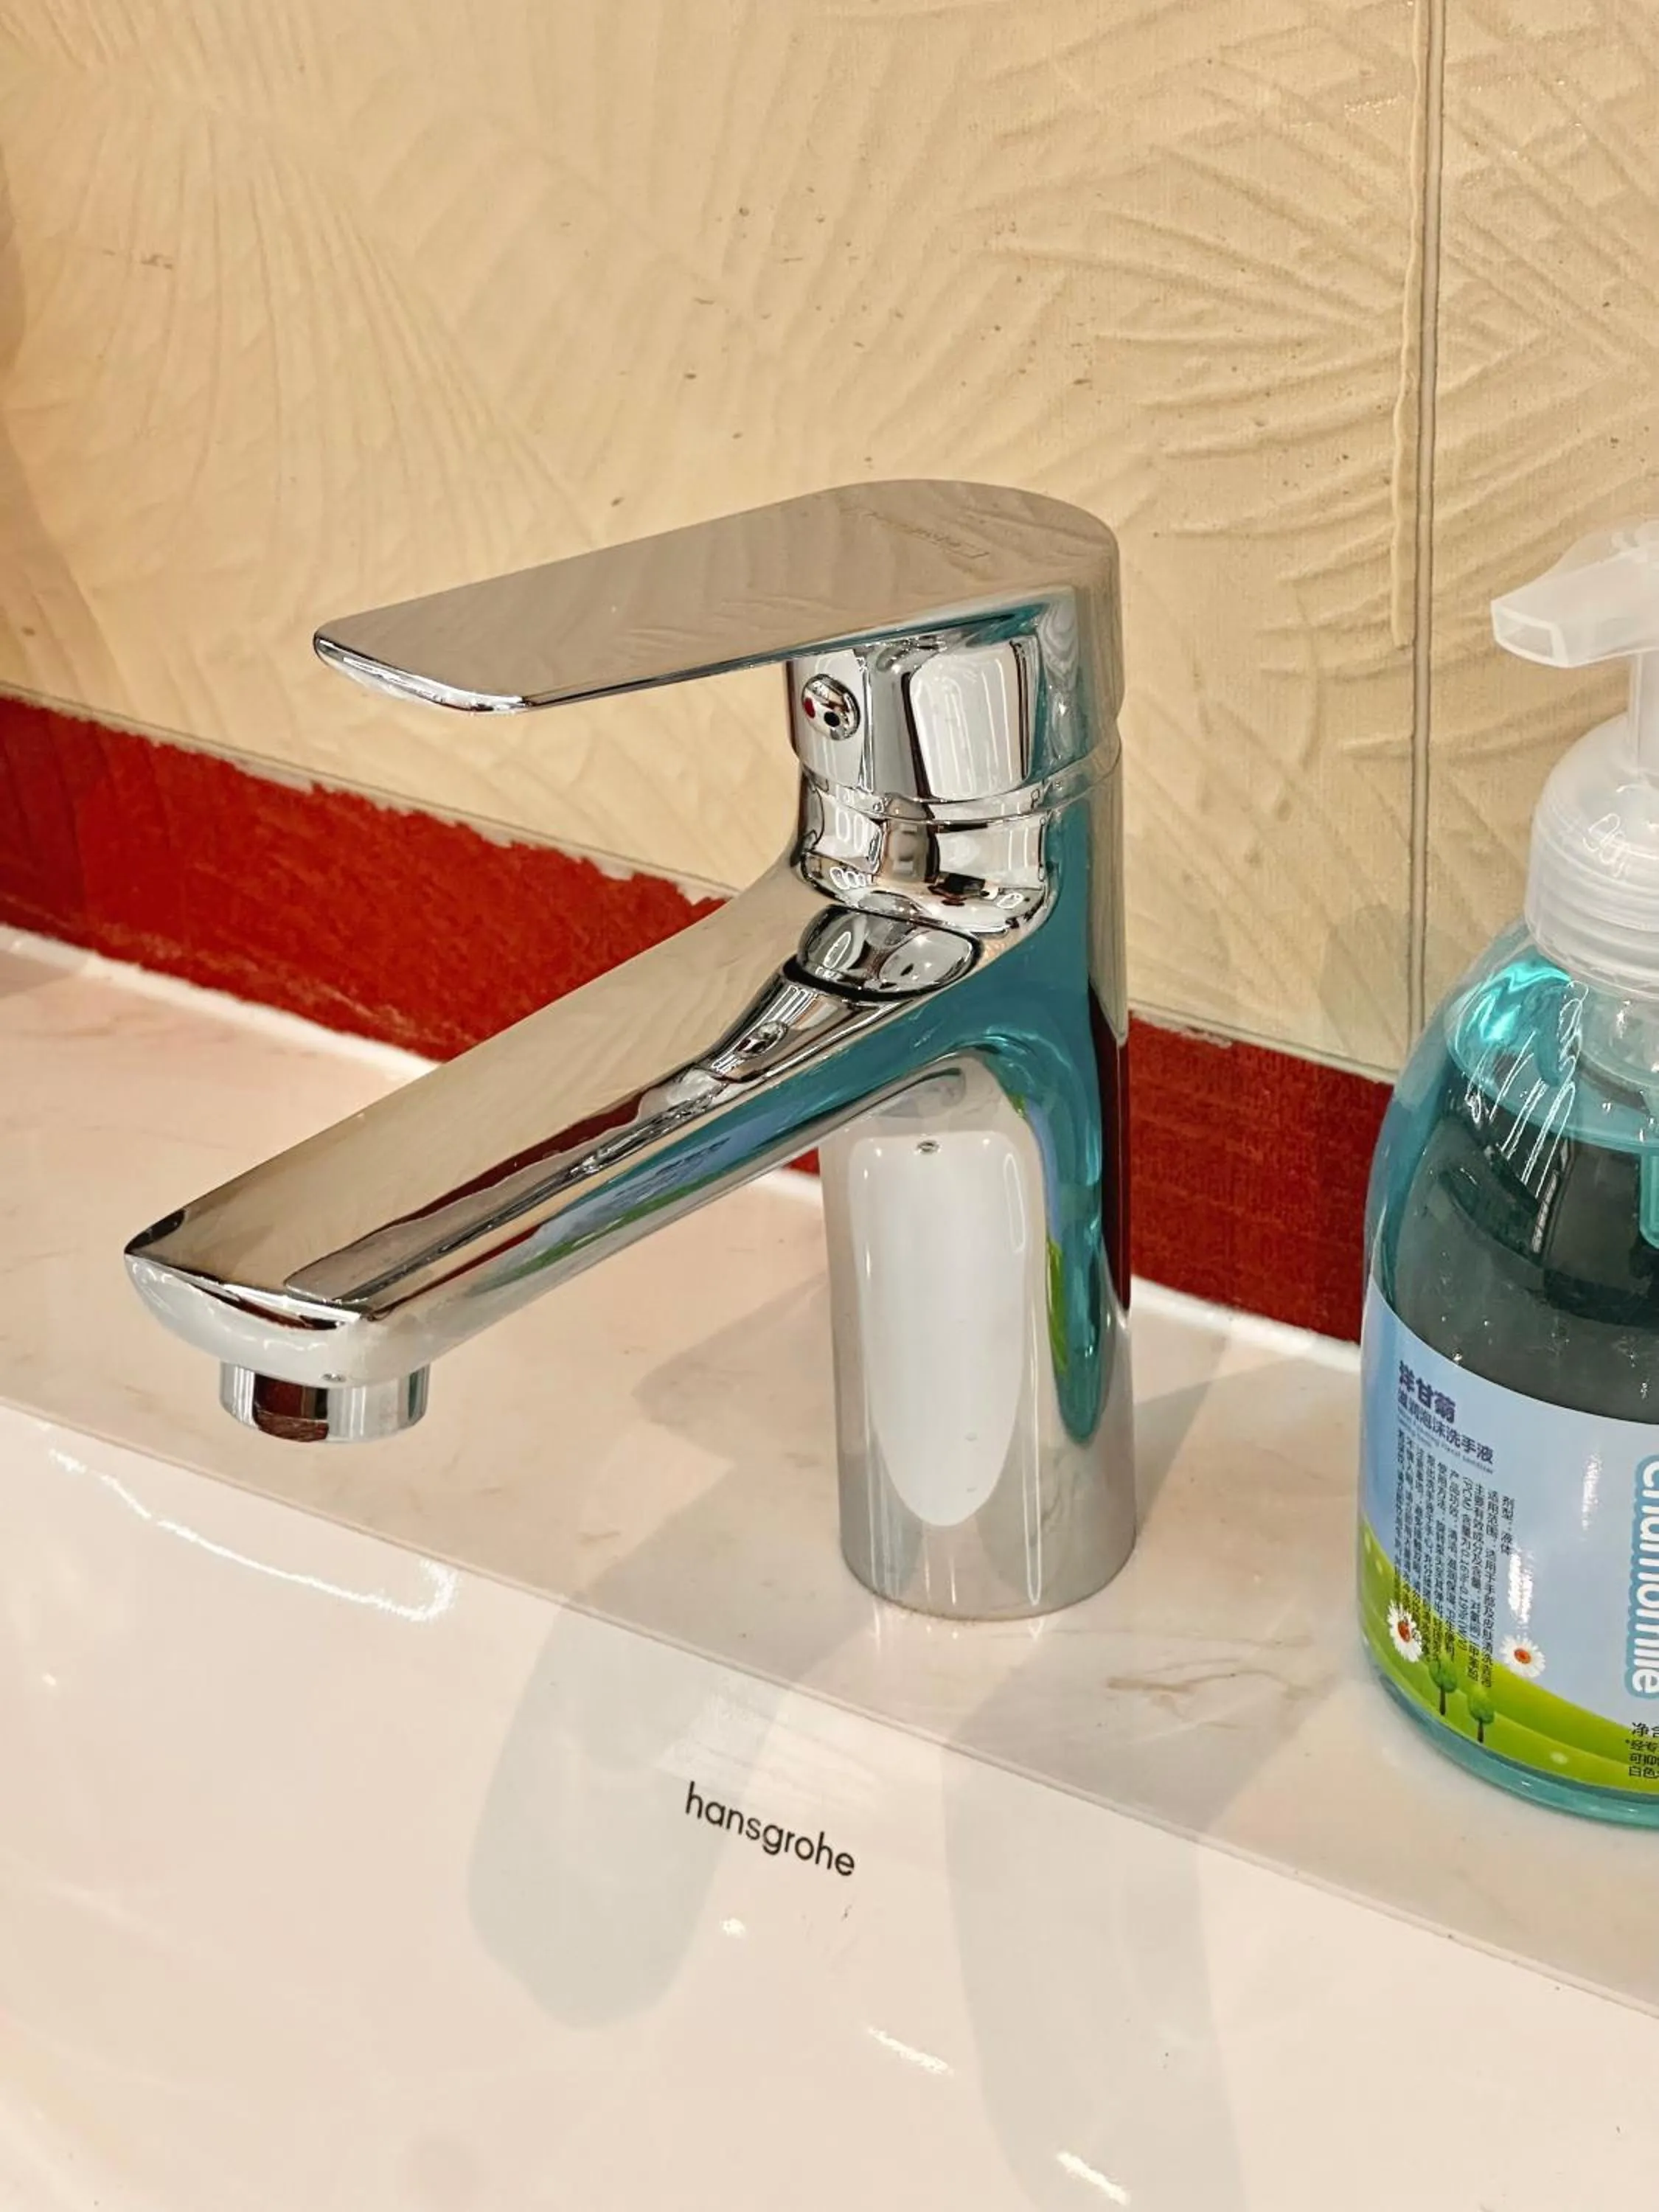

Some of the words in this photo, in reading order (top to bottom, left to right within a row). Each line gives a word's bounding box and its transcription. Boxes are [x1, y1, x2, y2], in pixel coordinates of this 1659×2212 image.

[1399, 1360, 1455, 1423] 洋甘菊
[1628, 1765, 1659, 1779] 白色
[684, 1780, 855, 1877] hansgrohe
